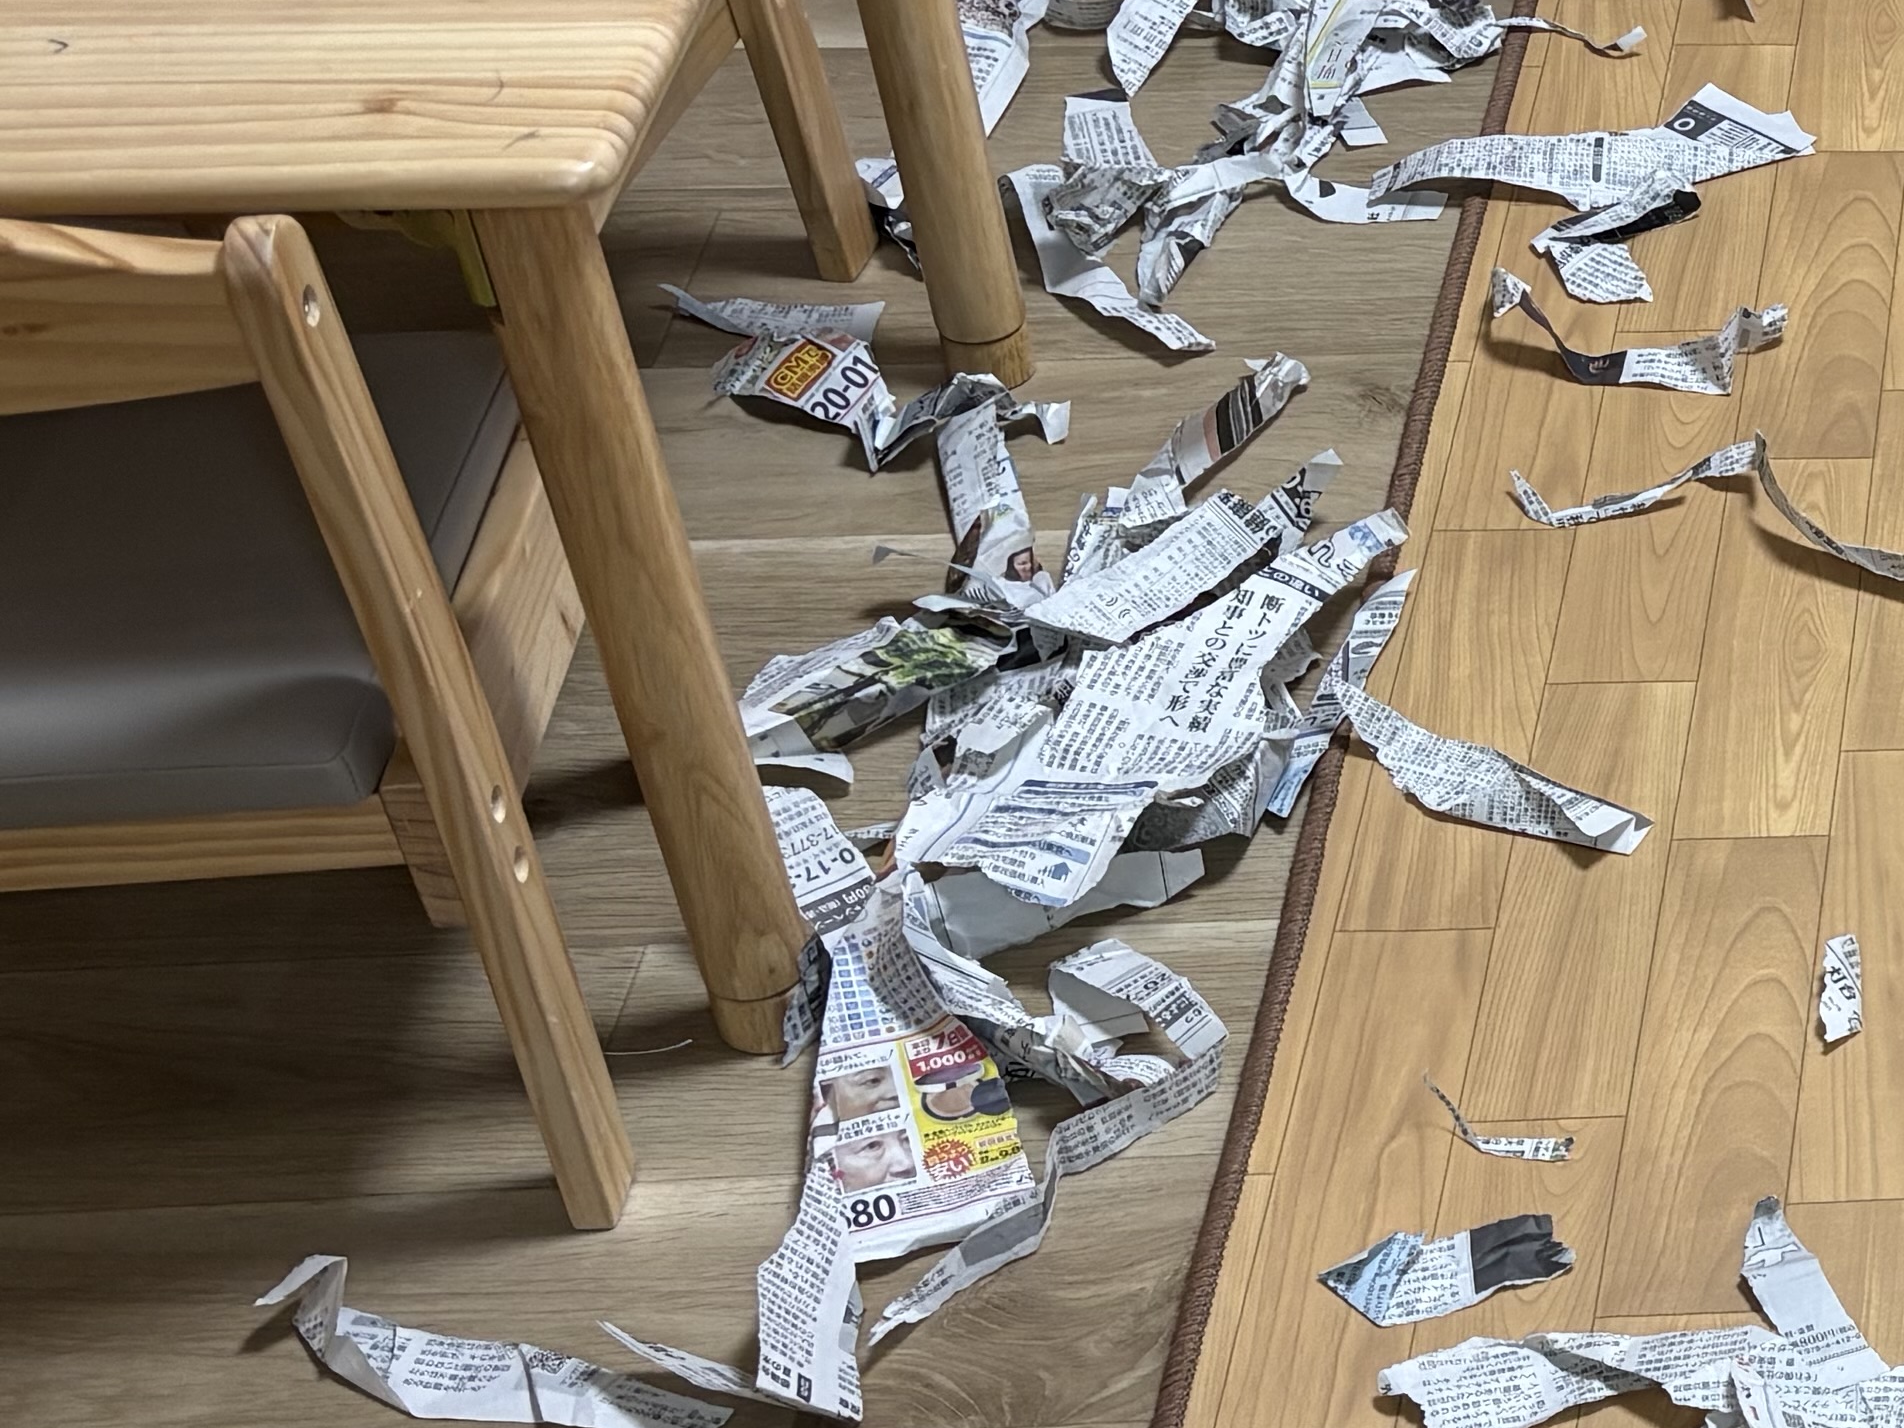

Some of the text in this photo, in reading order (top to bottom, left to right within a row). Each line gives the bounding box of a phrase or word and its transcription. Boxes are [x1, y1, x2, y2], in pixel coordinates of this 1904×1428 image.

[810, 352, 880, 421] 20-01
[1187, 592, 1286, 734] 断トツに豊富な実績
